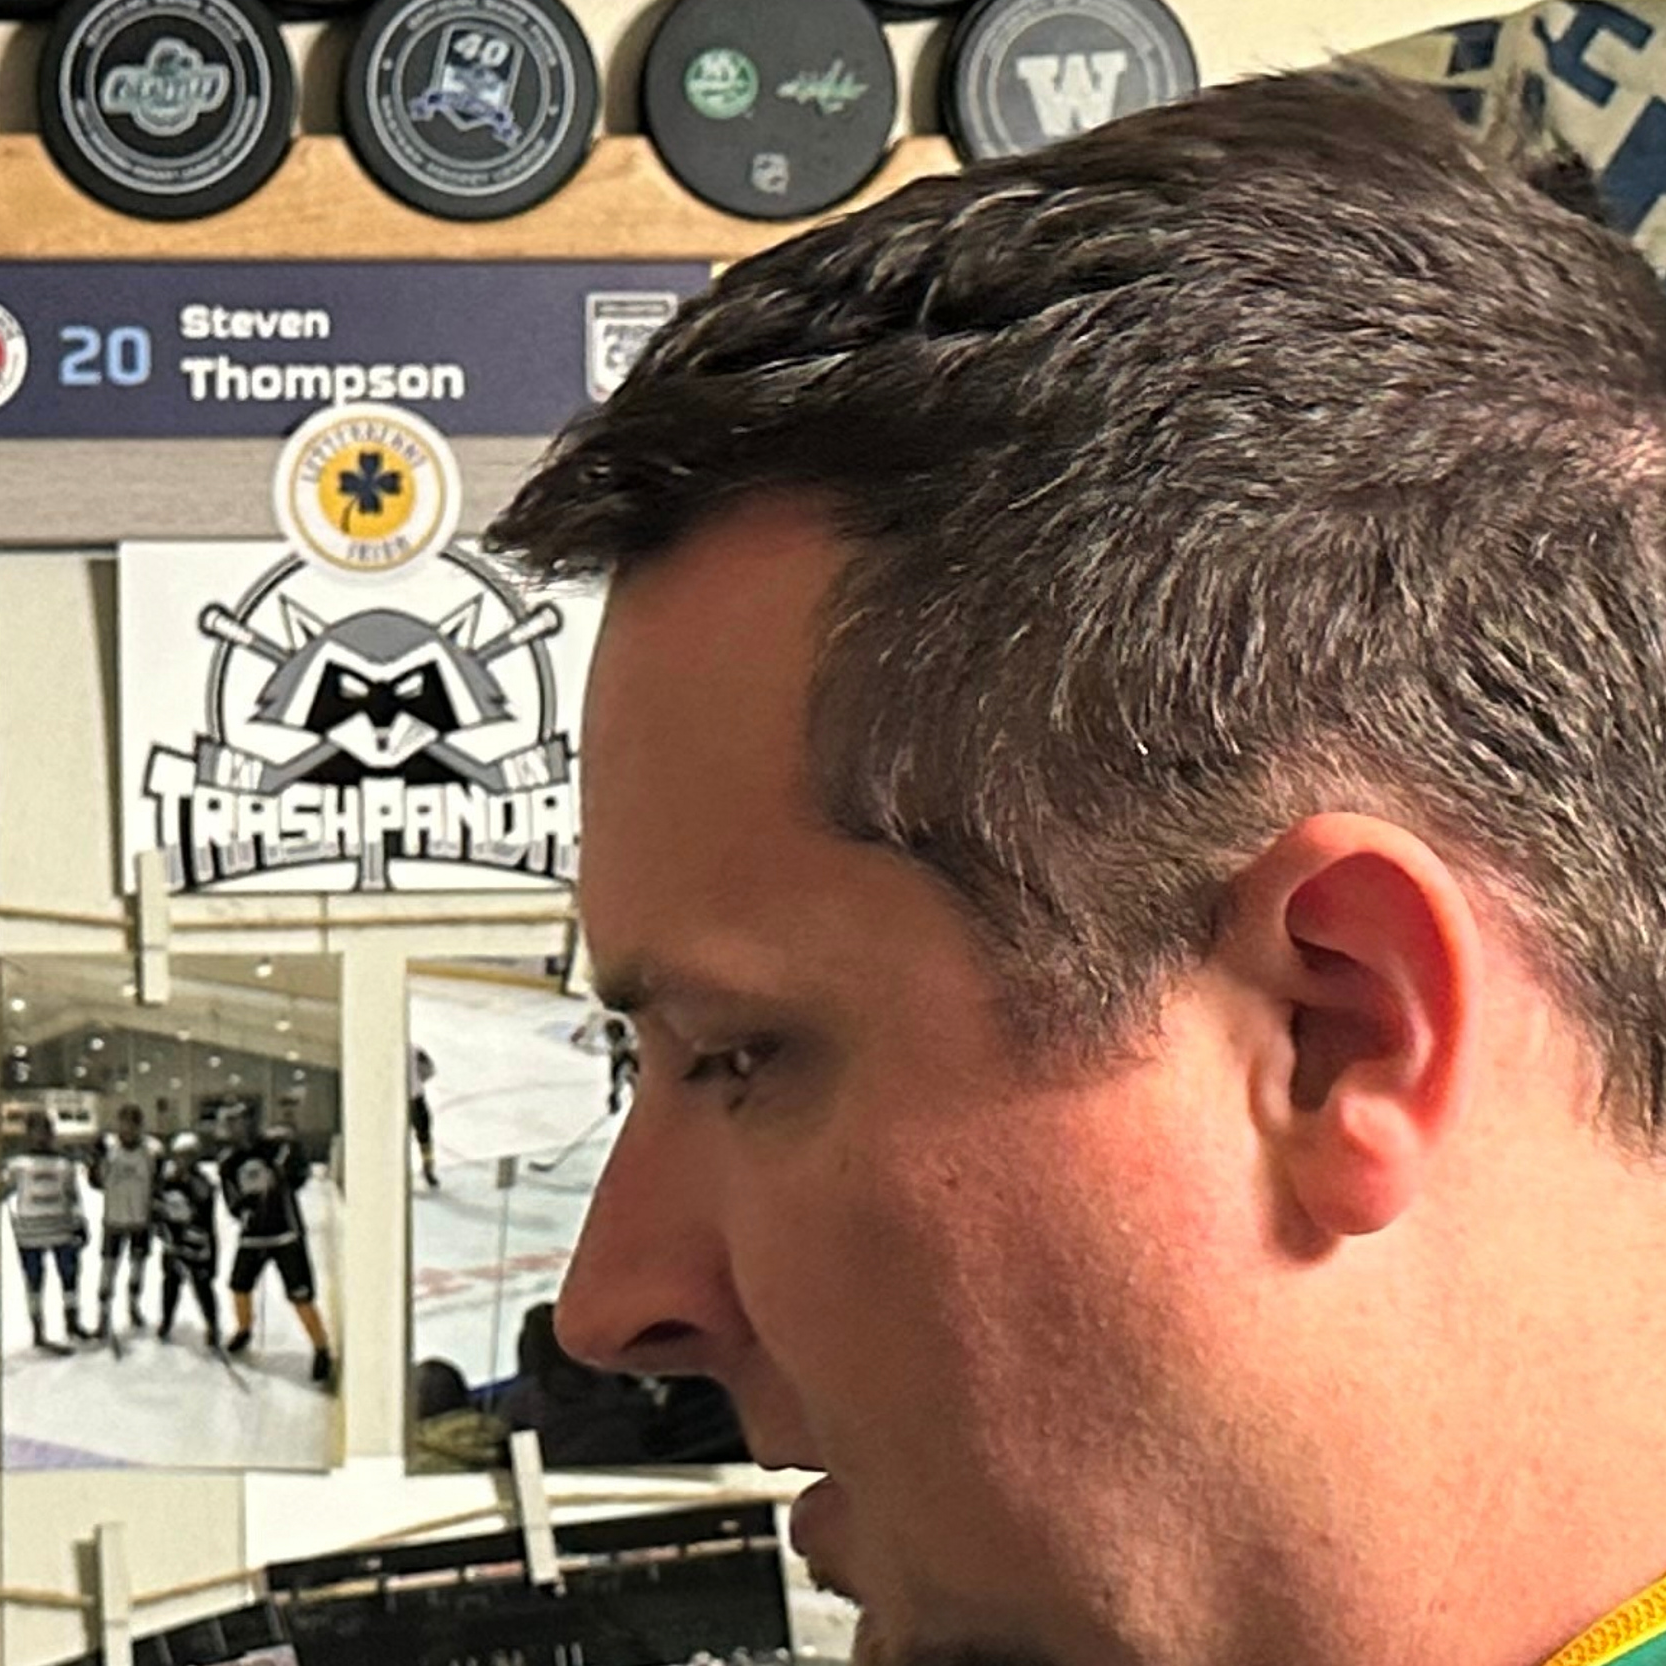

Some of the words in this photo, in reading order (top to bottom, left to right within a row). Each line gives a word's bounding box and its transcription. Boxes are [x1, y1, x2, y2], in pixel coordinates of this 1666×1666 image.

[454, 33, 510, 67] 40
[1017, 51, 1128, 136] W
[180, 304, 330, 339] Steven
[60, 326, 150, 385] 20
[180, 357, 465, 408] Thompson
[144, 738, 579, 890] TRASHPANDA
